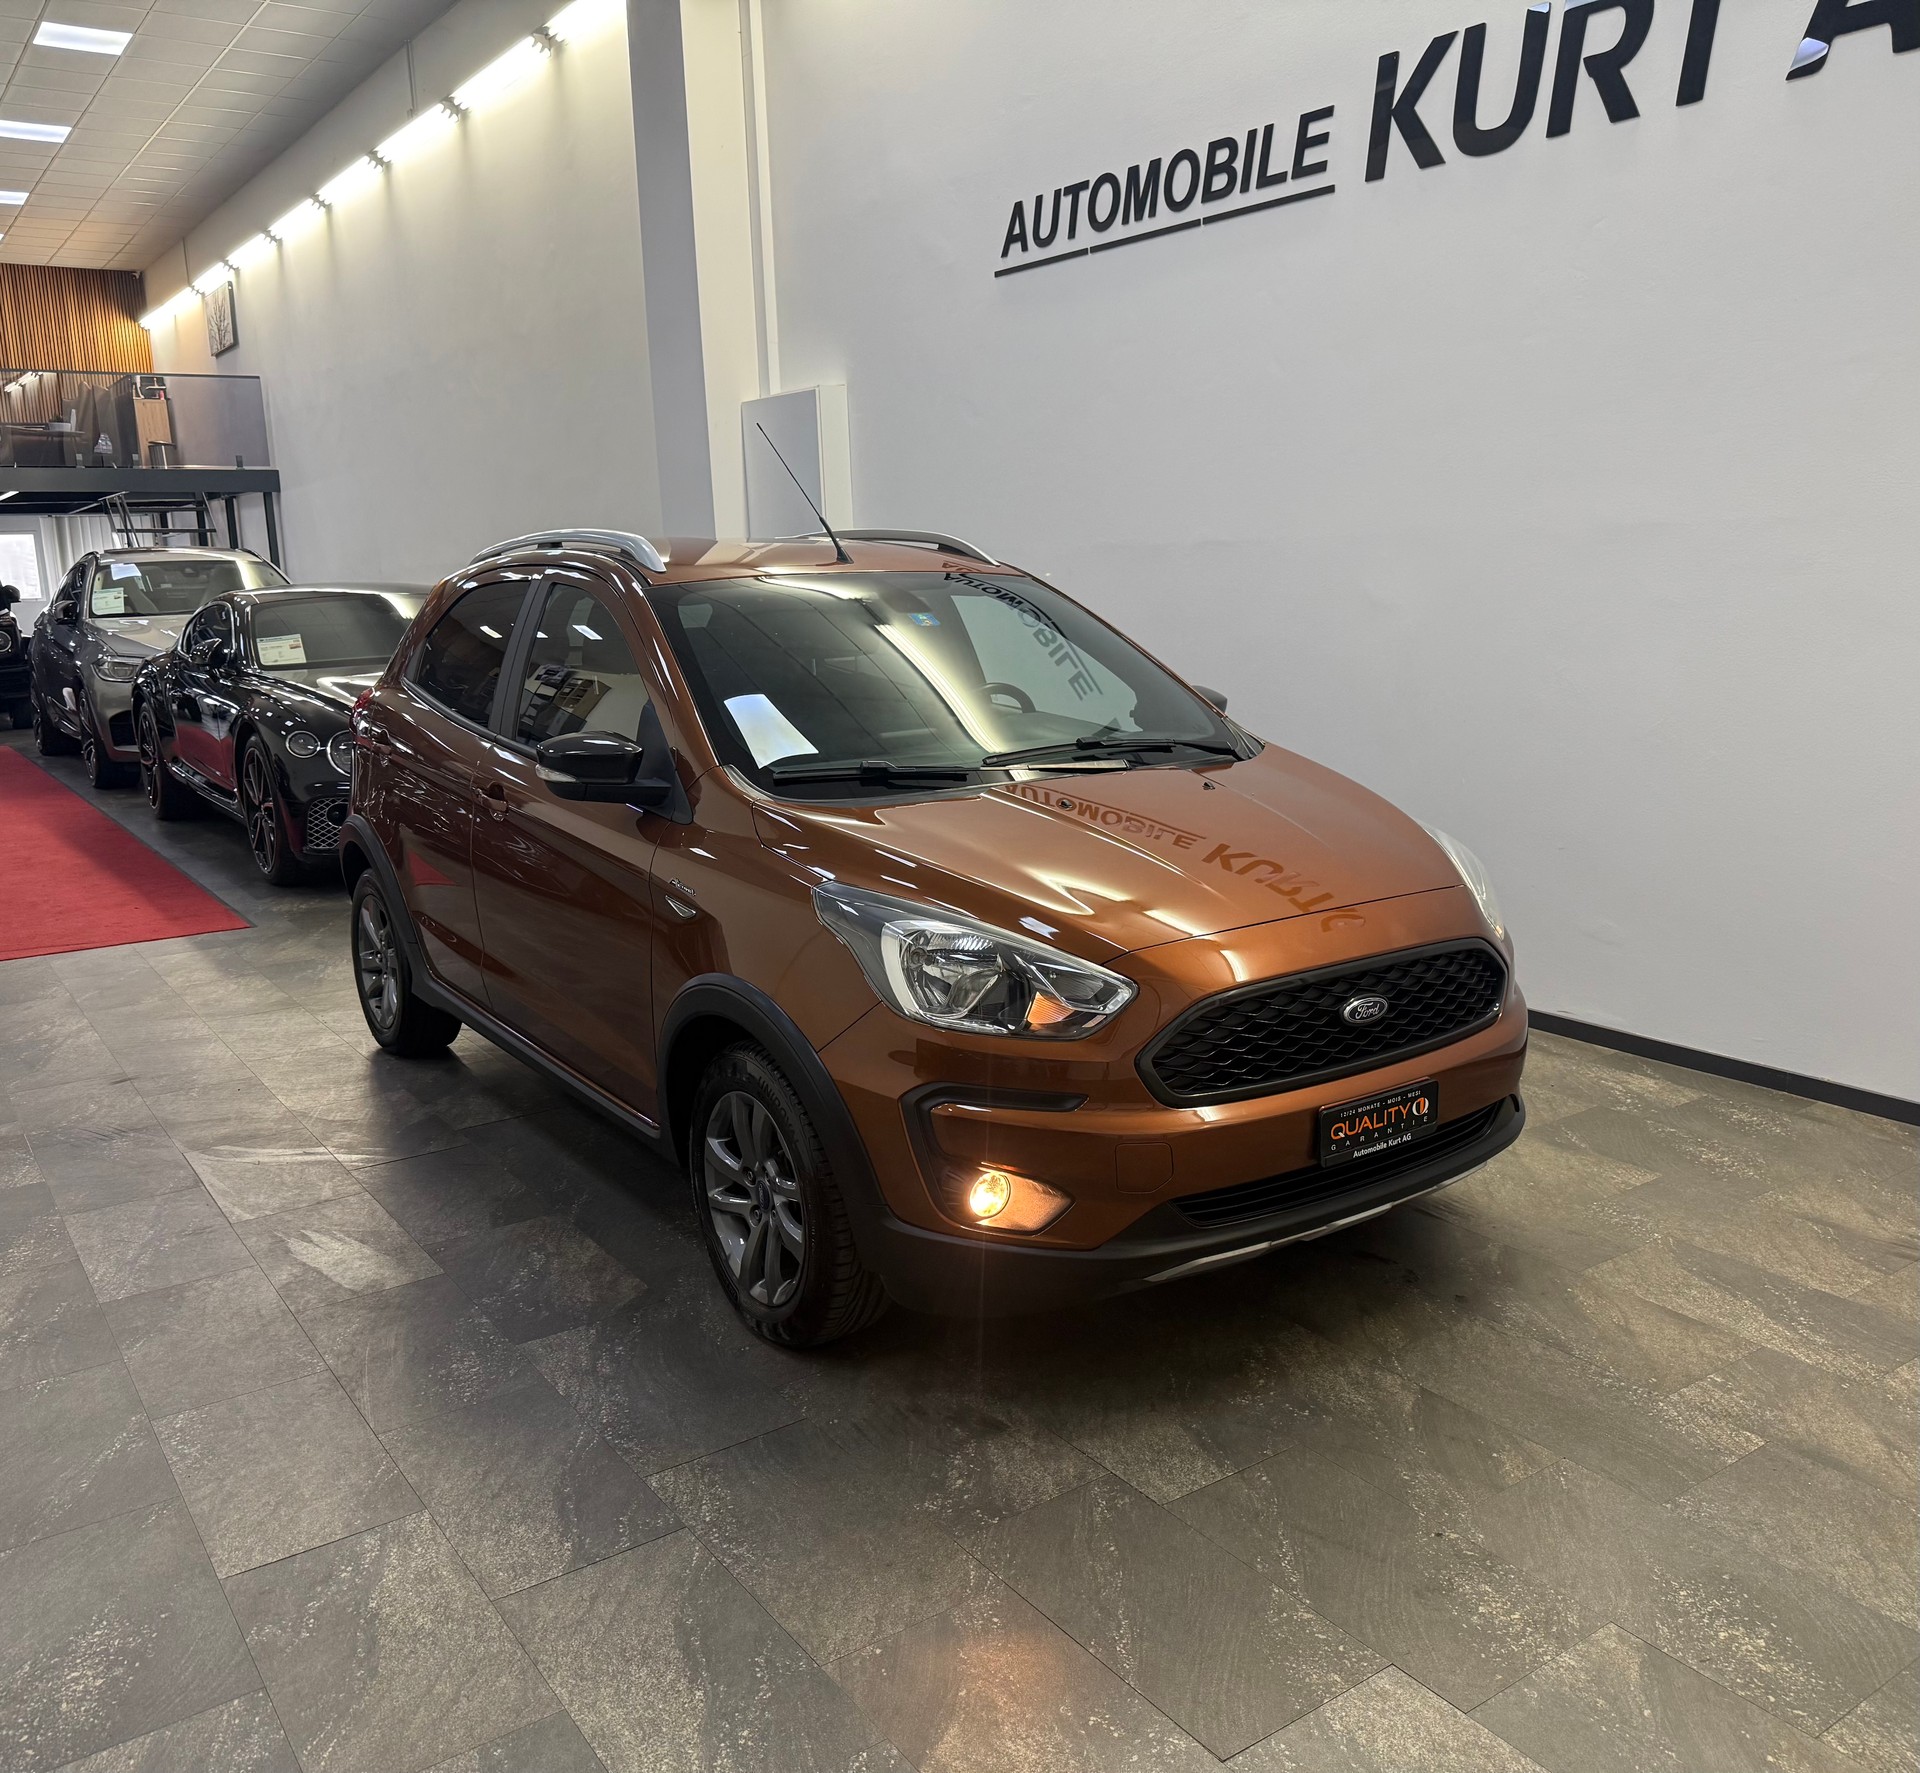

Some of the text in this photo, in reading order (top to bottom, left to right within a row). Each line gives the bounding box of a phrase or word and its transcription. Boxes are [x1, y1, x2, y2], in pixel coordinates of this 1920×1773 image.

[1001, 105, 1335, 258] AUTOMOBILE
[1355, 1002, 1380, 1019] Ford
[1358, 1102, 1380, 1113] MONATE
[1387, 1096, 1401, 1104] MOIS
[1331, 1116, 1428, 1151] GARANTIE
[1353, 1133, 1412, 1158] Automobile Kurt AG
